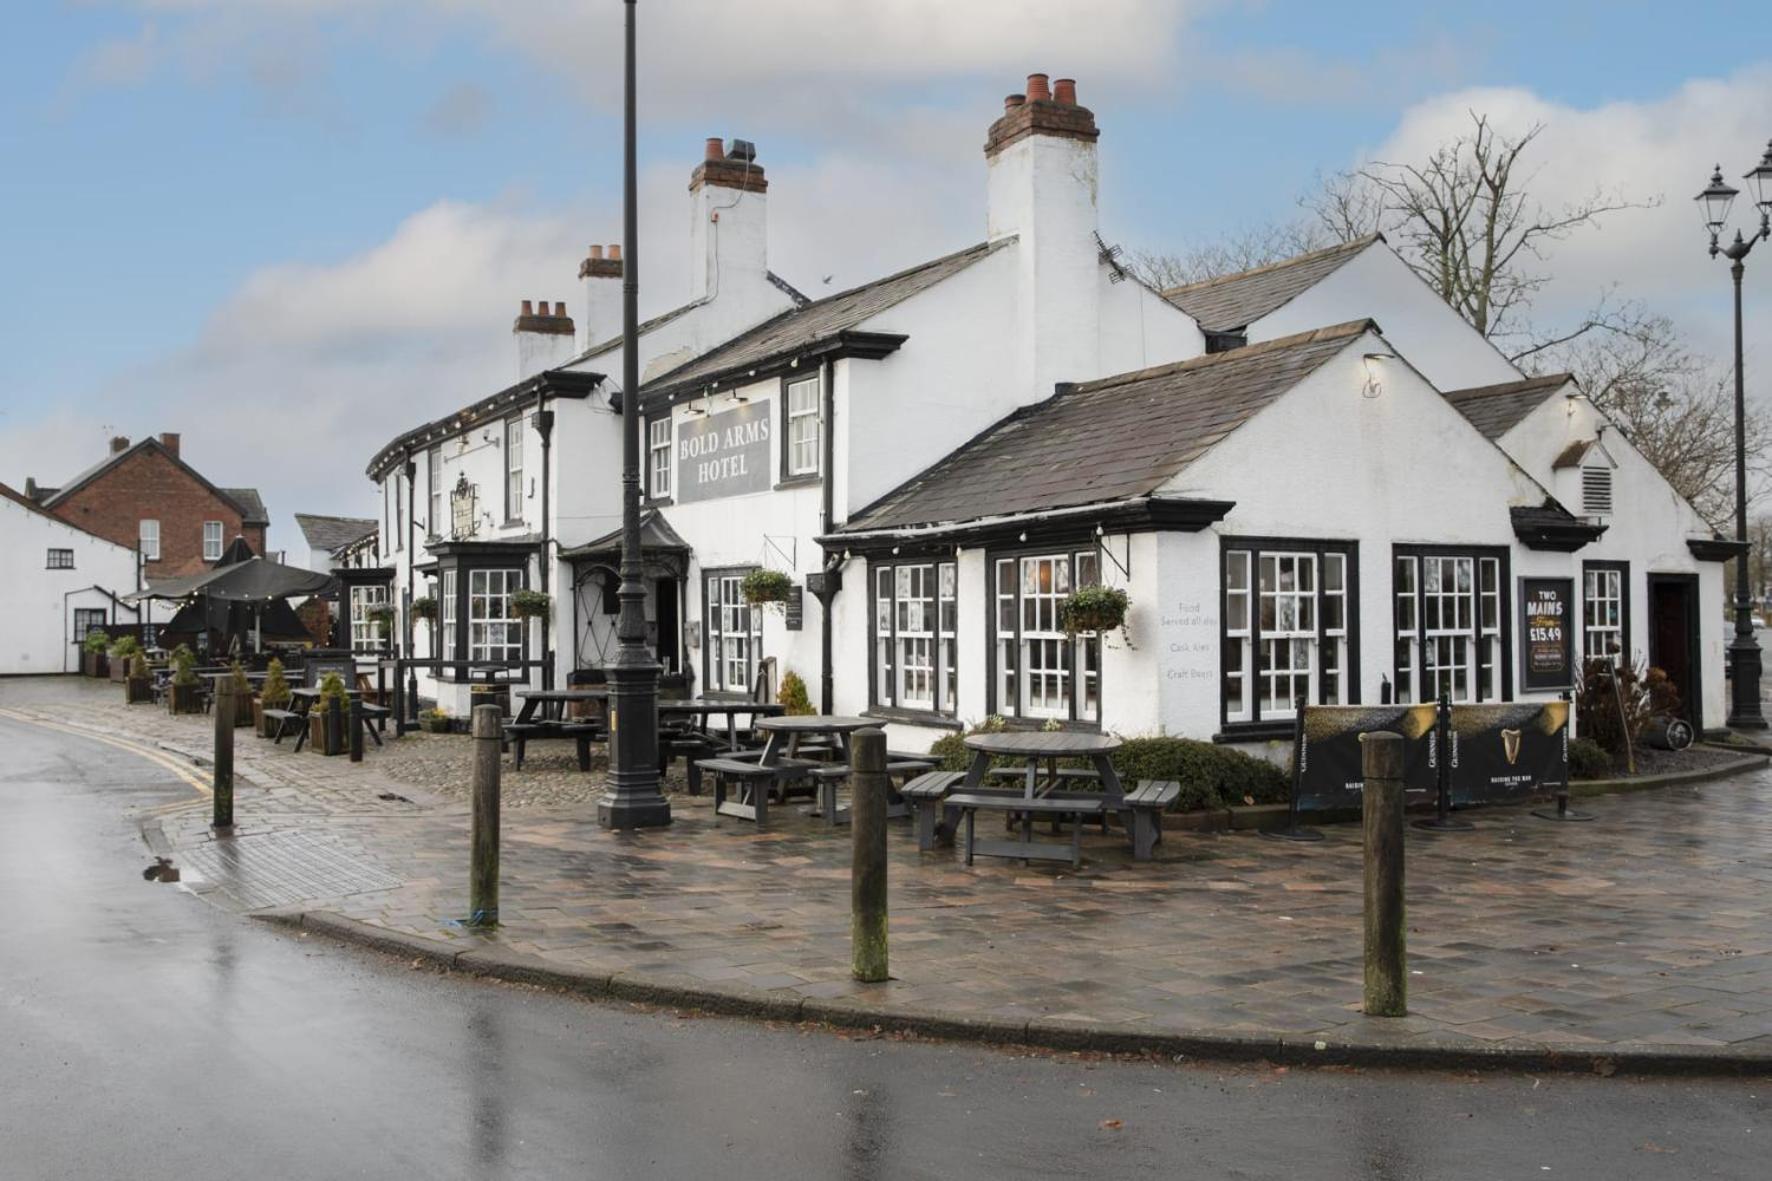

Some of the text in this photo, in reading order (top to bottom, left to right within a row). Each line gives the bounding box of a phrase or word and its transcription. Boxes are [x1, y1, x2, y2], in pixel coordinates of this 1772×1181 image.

[680, 418, 769, 460] BOLD ARMS
[698, 454, 748, 483] HOTEL
[1538, 590, 1557, 600] TWO
[1527, 602, 1563, 616] MAINS
[1530, 628, 1562, 641] £15.49
